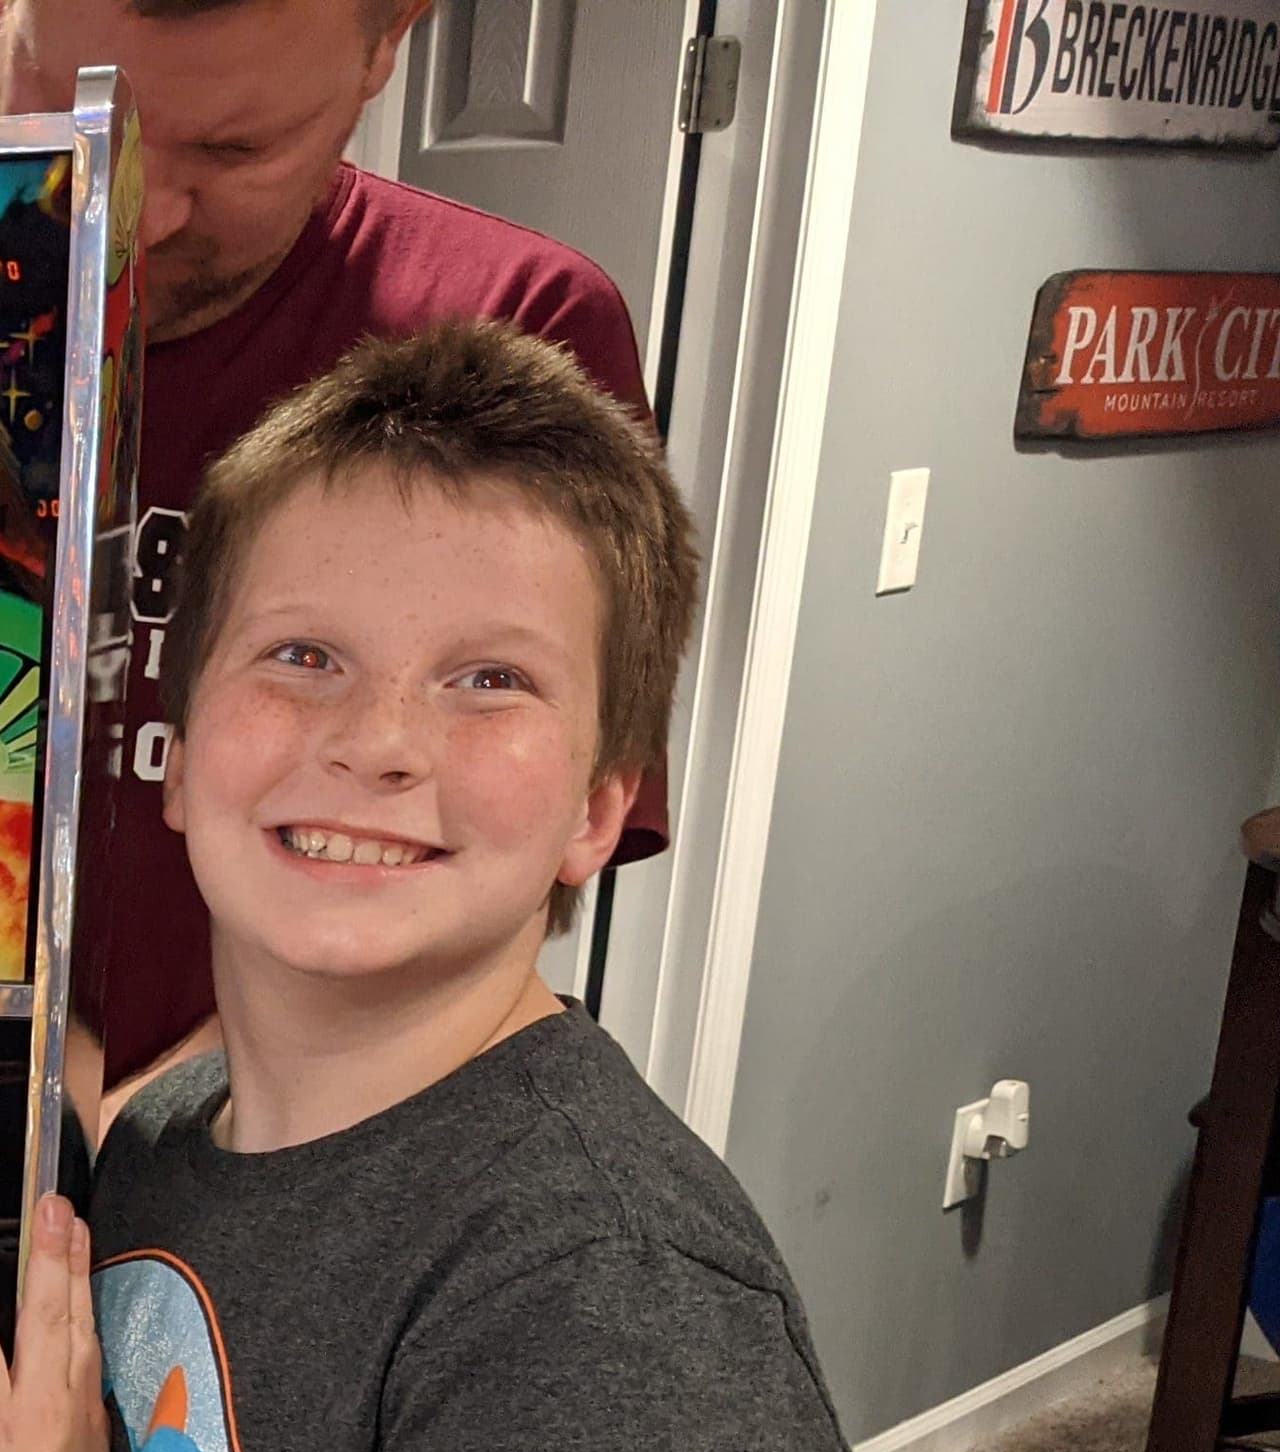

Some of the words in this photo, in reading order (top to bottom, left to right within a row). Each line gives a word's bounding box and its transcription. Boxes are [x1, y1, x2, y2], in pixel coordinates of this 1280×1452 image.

[1055, 304, 1197, 385] PARK
[1103, 391, 1187, 412] MOUNTAIN
[1197, 388, 1258, 410] RESORT
